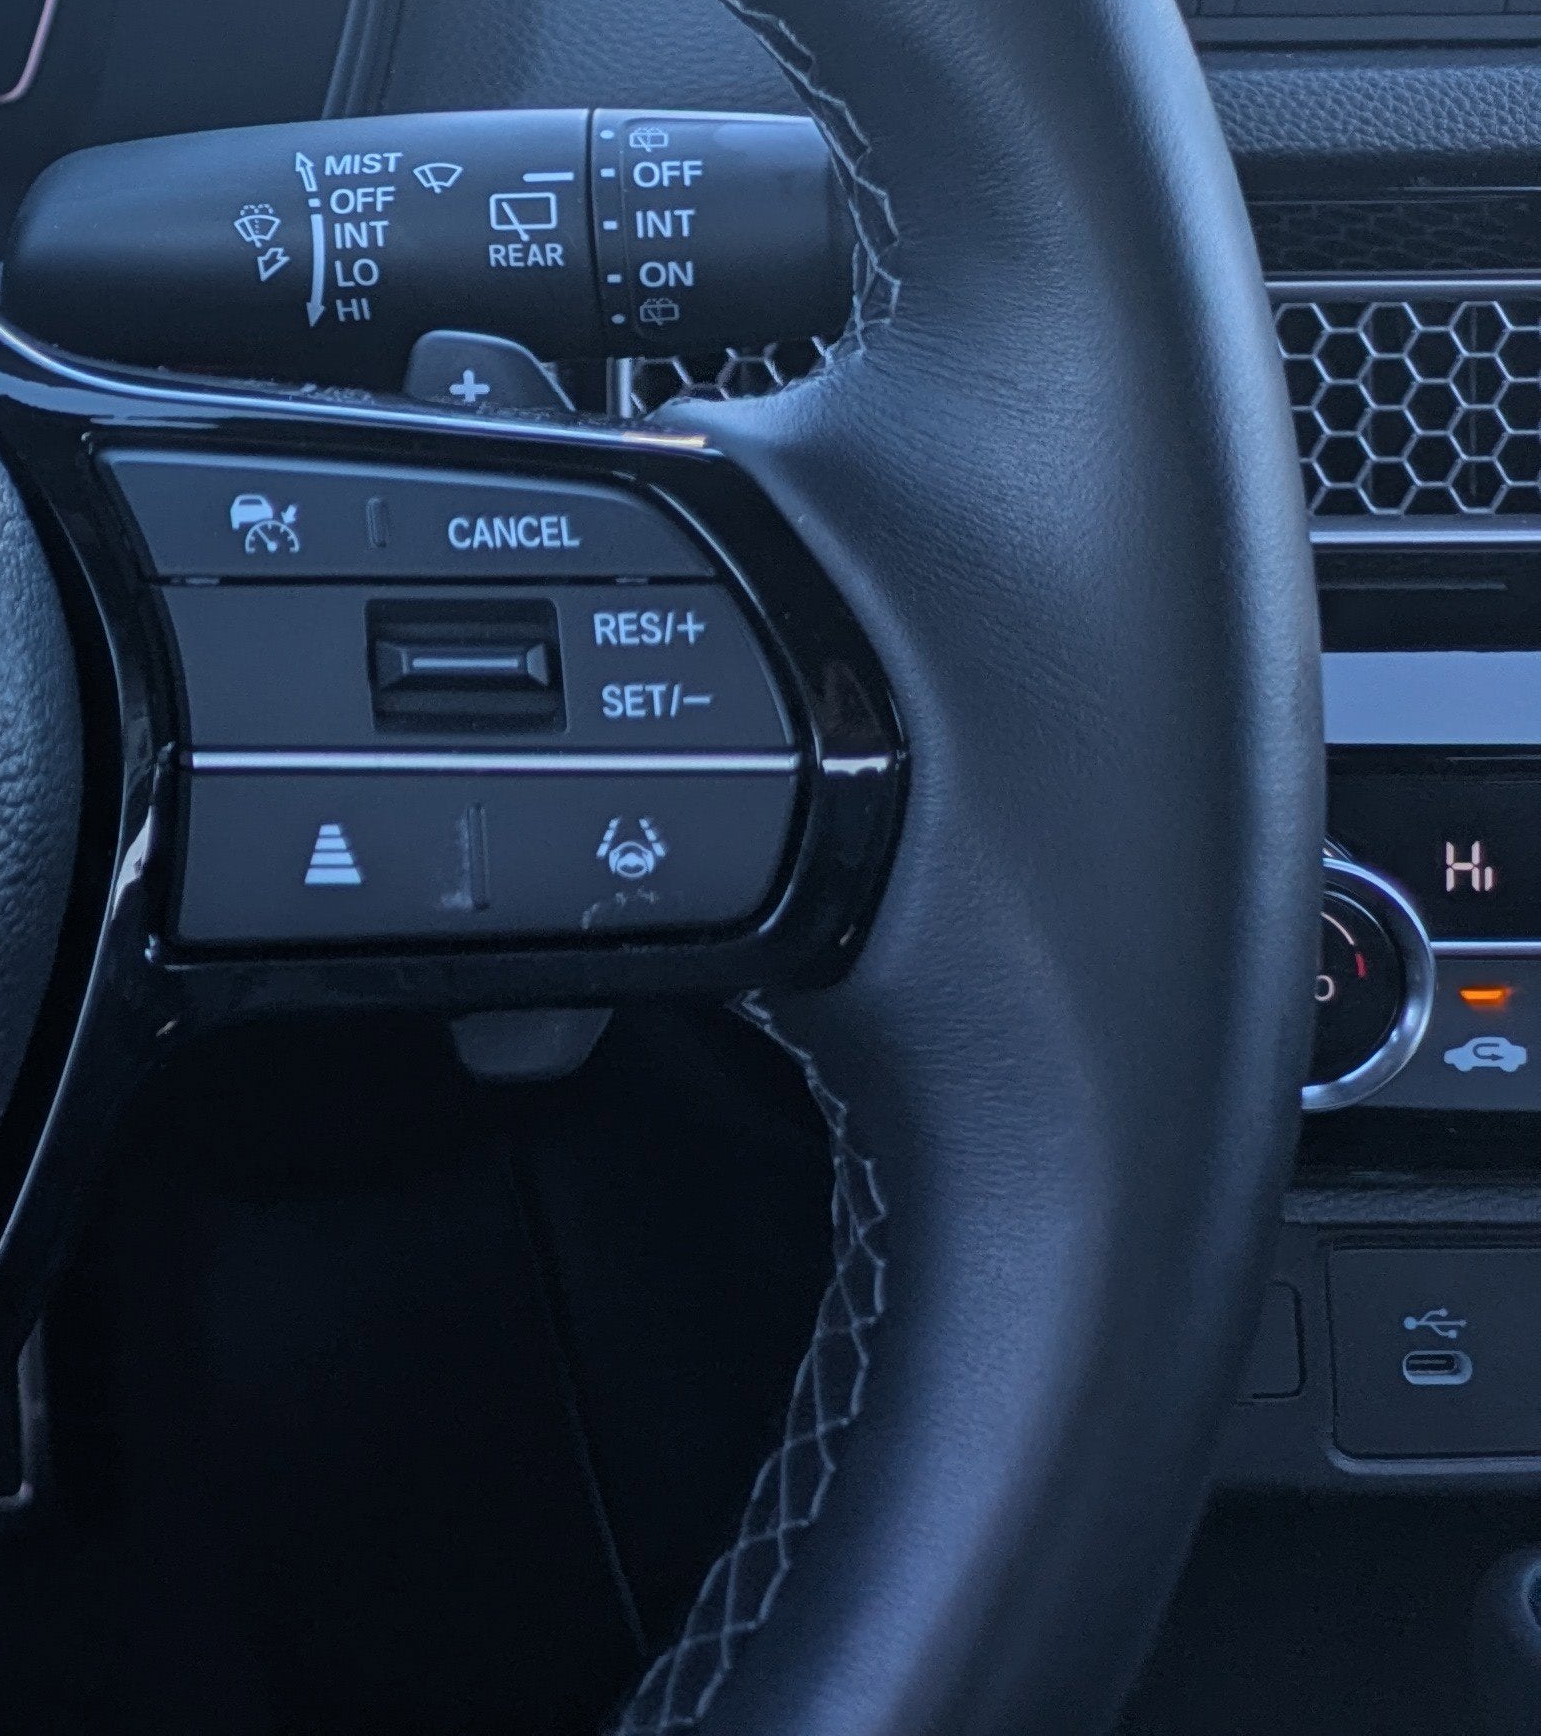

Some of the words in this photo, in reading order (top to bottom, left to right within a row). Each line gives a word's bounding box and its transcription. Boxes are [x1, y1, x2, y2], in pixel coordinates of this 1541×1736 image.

[324, 152, 403, 177] MIST
[632, 160, 703, 188] OFF
[329, 187, 395, 215] OFF
[334, 220, 390, 249] INT
[635, 210, 696, 239] INT
[488, 242, 564, 269] REAR
[336, 258, 379, 288] LO
[638, 262, 695, 289] ON
[335, 298, 372, 323] HI
[447, 515, 581, 551] CANCEL
[592, 611, 707, 647] RES/+
